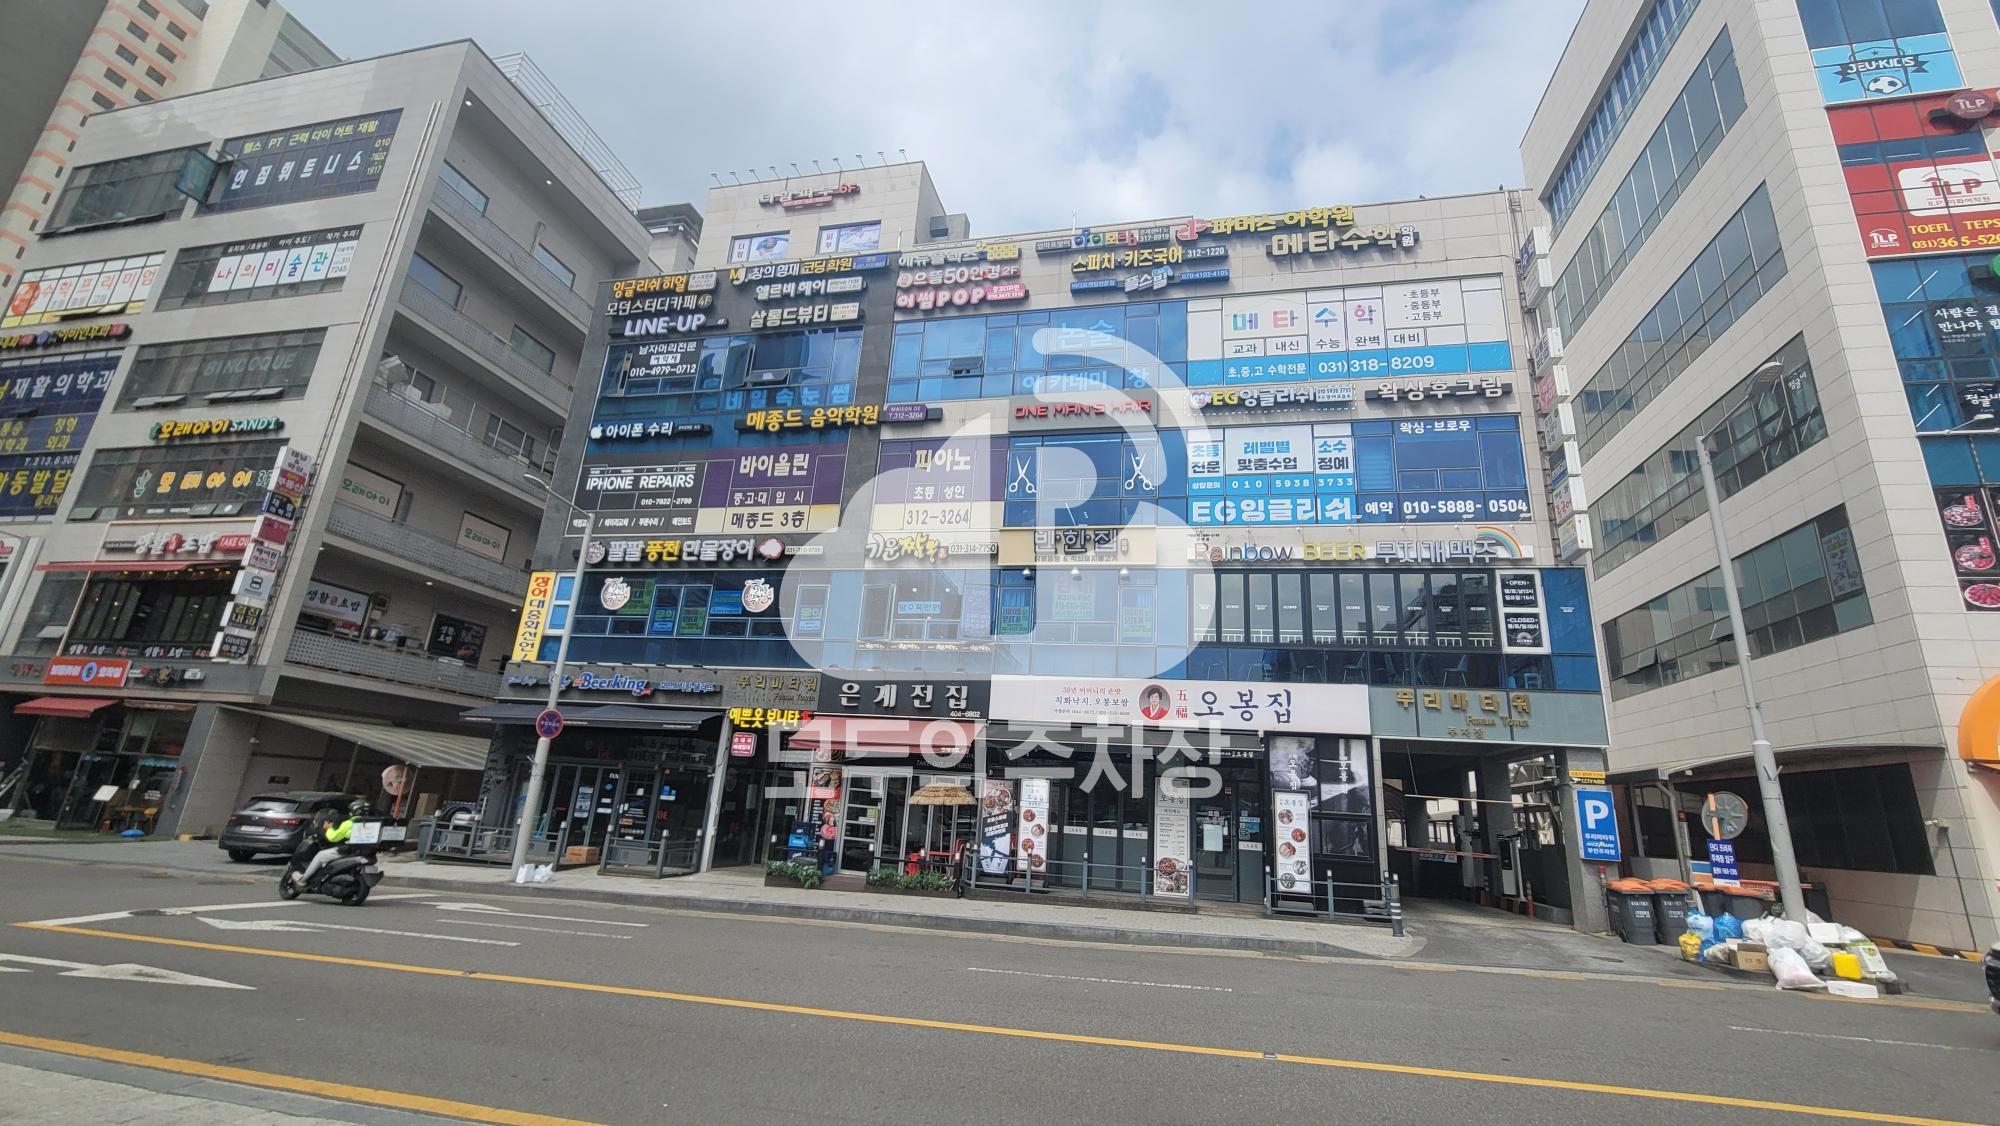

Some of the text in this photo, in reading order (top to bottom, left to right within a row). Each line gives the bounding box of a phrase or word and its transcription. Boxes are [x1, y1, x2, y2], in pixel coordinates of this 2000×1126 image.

[269, 137, 284, 148] PT
[374, 138, 391, 147] 010
[1283, 205, 1355, 227] 어학원
[1908, 218, 2000, 234] TOEFL TEPS
[1272, 224, 1402, 256] 메타수학
[1187, 247, 1225, 257] 312-1220
[776, 263, 800, 276] 영재
[801, 260, 827, 274] 코딩
[828, 257, 853, 271] 학원
[613, 278, 660, 298] 잉글리쉬
[798, 279, 826, 296] 헤어
[1409, 288, 1440, 299] 초등부
[605, 294, 698, 316] 모던스터디카페
[1410, 300, 1442, 310] 중등부
[1935, 306, 1979, 320] 사람은
[751, 304, 829, 329] 살롱드뷰티
[1233, 304, 1376, 331] 메타수학
[1411, 310, 1443, 321] 고등부
[624, 313, 707, 337] LINE-UP
[1938, 320, 1983, 332] 만나야
[639, 341, 698, 355] 남자머리전문
[1233, 332, 1420, 354] 교과 내신 수능 완벽 대비
[630, 364, 697, 378] 010-4979-0712
[1267, 363, 1306, 376] 수학전문
[1318, 355, 1435, 374] 031)318-8209
[11, 369, 115, 399] 재활의학과
[1378, 377, 1503, 401] 왁싱후그림
[1212, 385, 1314, 407] EG잉글리쉬
[746, 405, 880, 430] 메종드 음악학원
[1014, 404, 1048, 418] ONE
[606, 423, 643, 438] 아이폰
[647, 421, 674, 436] 수리
[1243, 440, 1291, 455] 레벨별
[1317, 440, 1347, 454] 소수
[740, 453, 810, 477] 바이올린
[914, 448, 972, 472] 피아노
[1192, 460, 1221, 475] 전문
[1237, 457, 1298, 471] 맞춤수업
[1317, 455, 1350, 471] 정예
[586, 474, 695, 492] IPHONE REPAIRS
[943, 485, 965, 499] 성인
[1232, 480, 1262, 489] 010
[1275, 478, 1311, 488] 5938
[1318, 477, 1353, 487] 3733
[1192, 497, 1353, 524] EG잉글리쉬
[1364, 499, 1528, 515] 예약 010-5888-0504
[731, 511, 805, 528] 메종드 3층
[907, 508, 969, 526] 312-3264
[646, 540, 682, 561] 풍천
[682, 538, 755, 562] 민물장어
[1194, 540, 1498, 565] Rainbow BEER 무지개맥주
[531, 576, 550, 597] 장어
[580, 671, 647, 696] Beerking
[1079, 686, 1107, 695] 어머니의
[839, 682, 969, 709] 은계전집
[1094, 697, 1128, 707] 오봉보쌈
[1193, 688, 1292, 724] 오봉집
[729, 707, 800, 729] 예쁜옷 보니타
[1585, 799, 1609, 829] P
